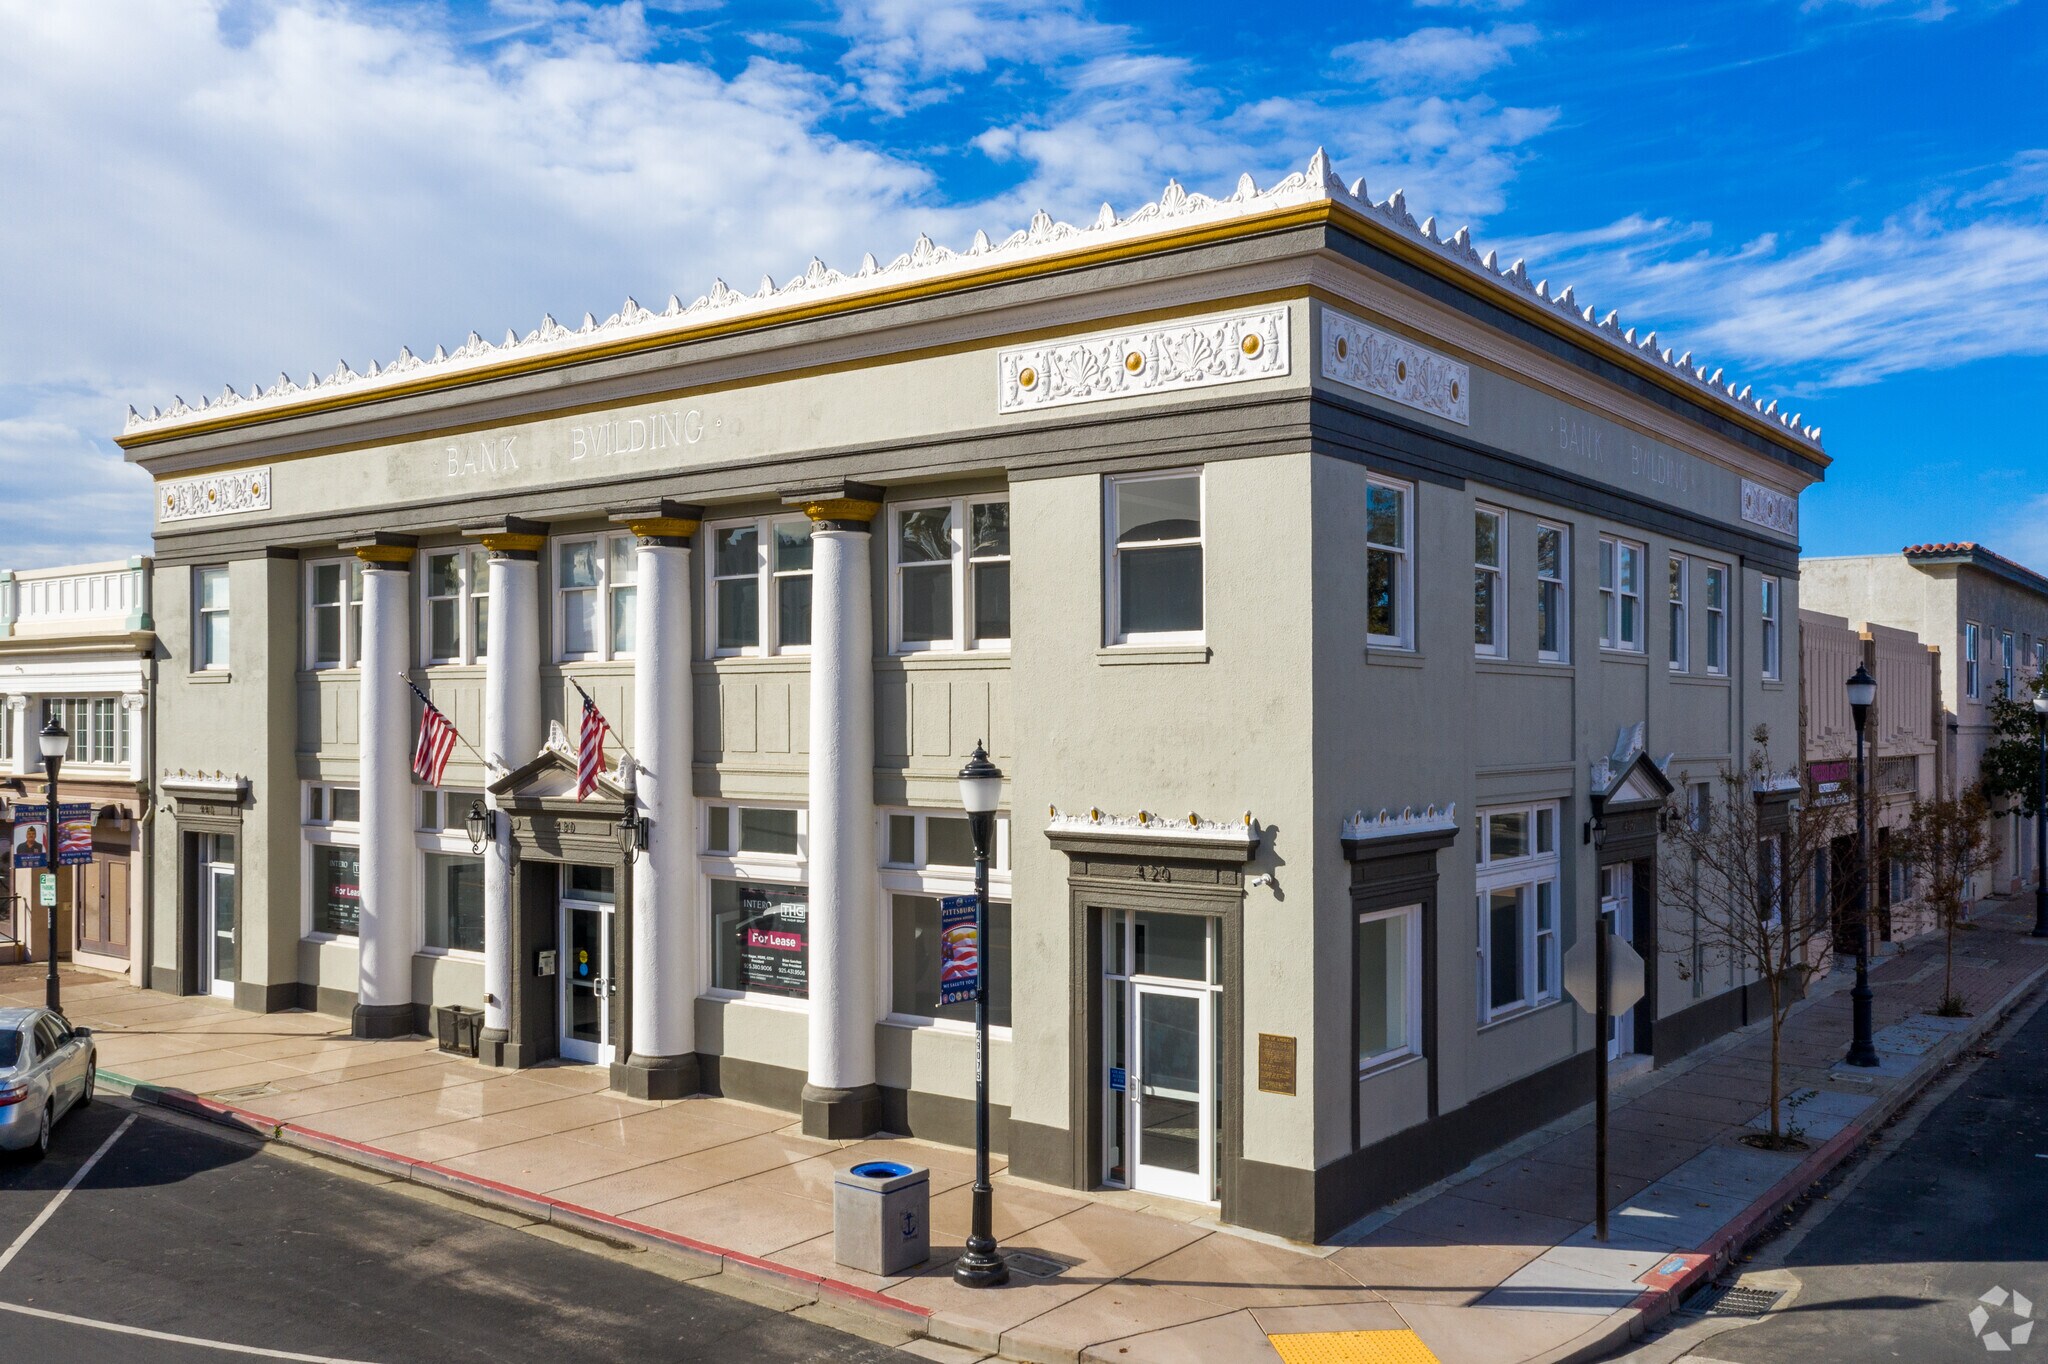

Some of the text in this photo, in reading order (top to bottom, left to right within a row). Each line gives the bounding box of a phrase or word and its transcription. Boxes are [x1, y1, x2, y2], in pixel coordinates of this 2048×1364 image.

[1559, 416, 1604, 463] BANK
[446, 435, 519, 477] BANK
[1134, 864, 1172, 883] 420
[335, 886, 360, 897] For Leas
[743, 899, 772, 909] INTERO
[782, 904, 804, 917] THG
[942, 905, 976, 916] PITTSBURG
[752, 932, 796, 947] For Lease
